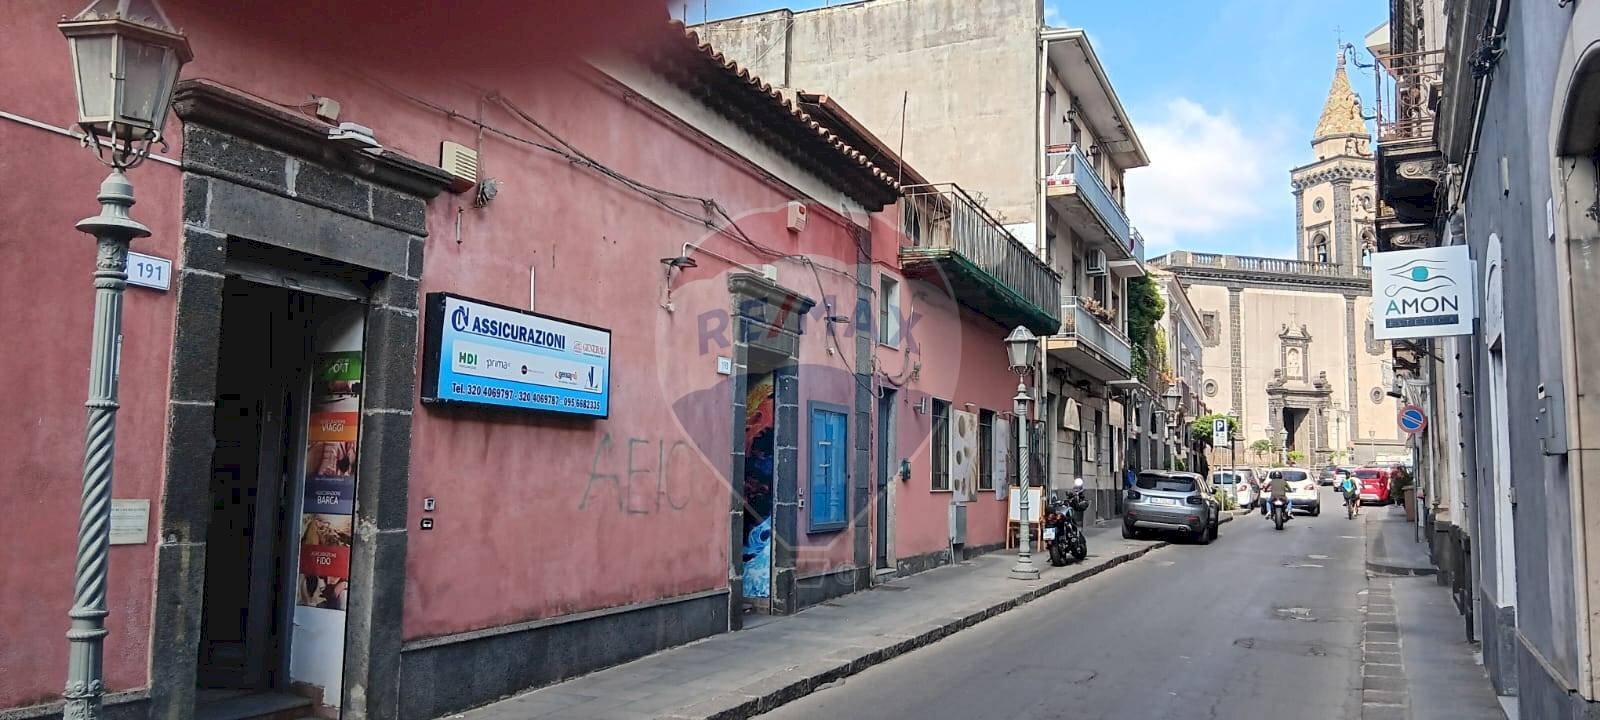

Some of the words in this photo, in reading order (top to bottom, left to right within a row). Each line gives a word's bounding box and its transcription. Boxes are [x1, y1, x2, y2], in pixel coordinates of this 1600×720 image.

[137, 262, 162, 281] 191
[1385, 295, 1459, 316] AMON
[472, 316, 566, 350] ASSICURAZIONI
[459, 352, 478, 366] HDI
[452, 382, 465, 394] Tel.
[467, 384, 481, 396] 320
[483, 386, 514, 400] 4069797
[518, 391, 531, 402] 320
[321, 423, 344, 432] VIAGGI
[1216, 420, 1224, 431] P
[317, 495, 339, 505] BARCA
[316, 556, 331, 566] FIDO
